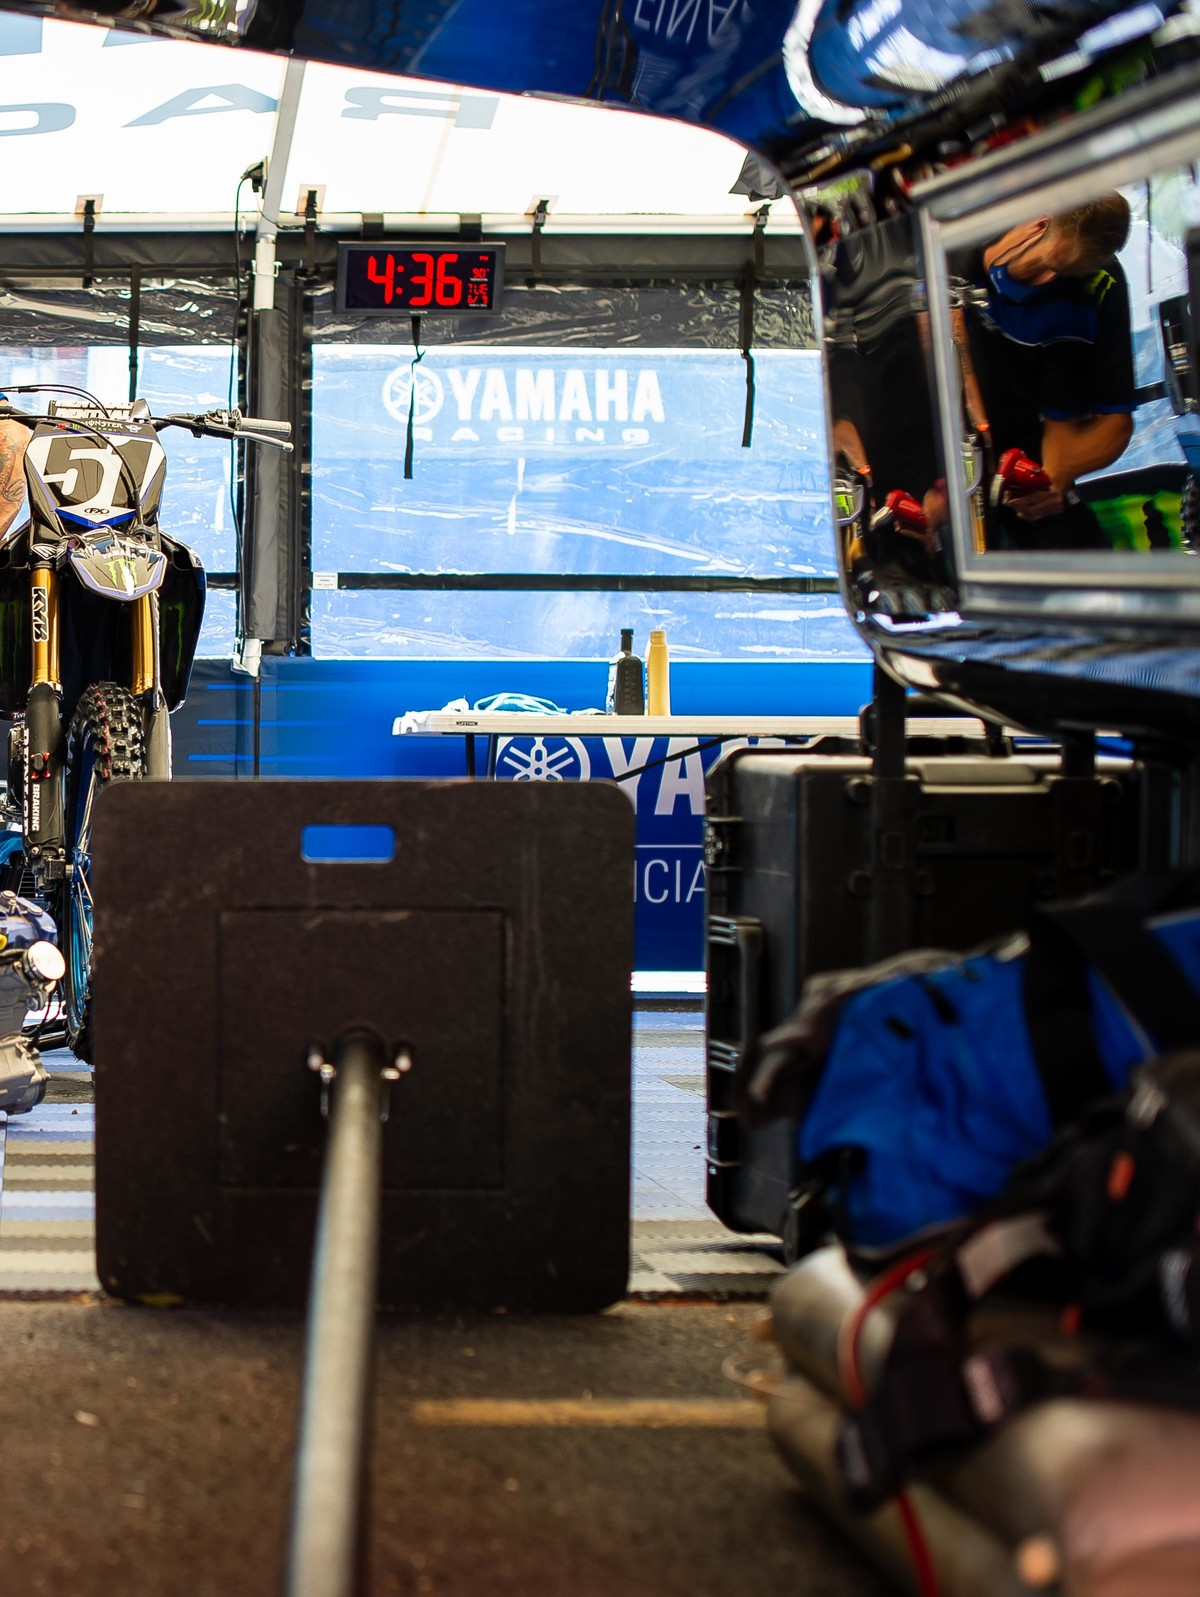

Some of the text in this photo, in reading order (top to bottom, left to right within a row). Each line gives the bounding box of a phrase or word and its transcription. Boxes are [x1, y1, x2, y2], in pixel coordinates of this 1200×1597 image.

[367, 253, 463, 306] 4:36
[447, 368, 665, 423] YAMAHA
[43, 435, 153, 507] 51
[32, 587, 49, 642] KYB
[31, 783, 41, 832] BRAKING
